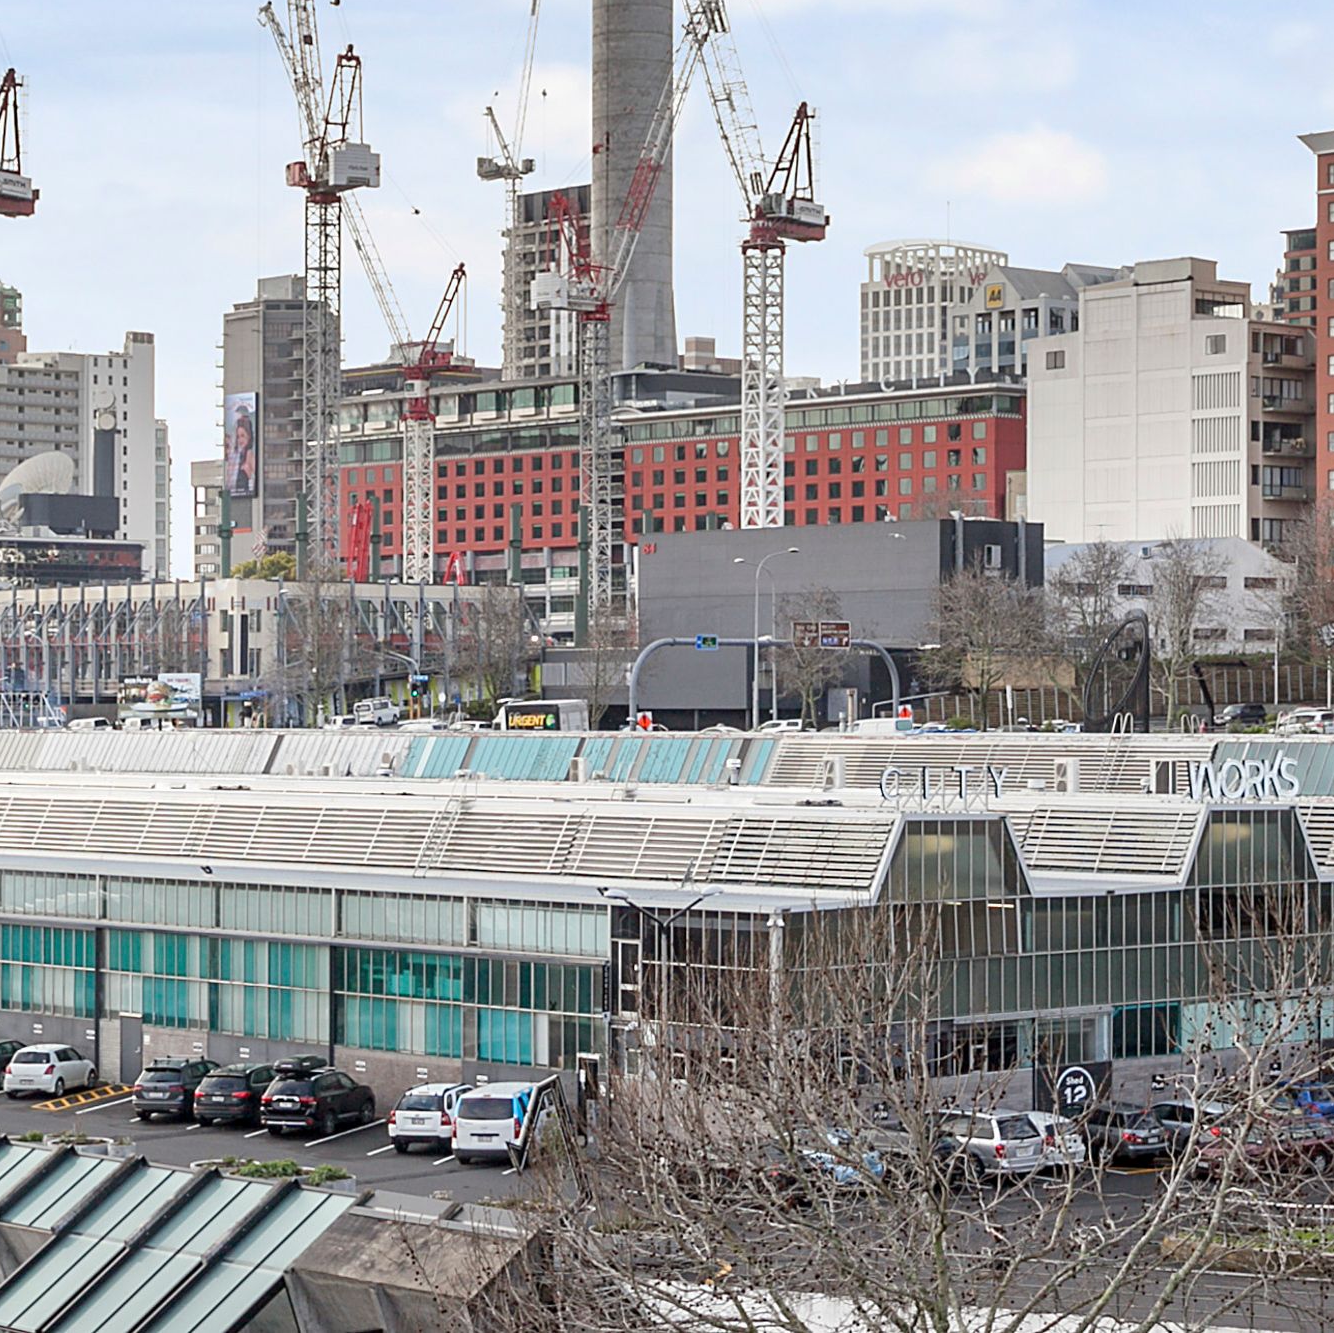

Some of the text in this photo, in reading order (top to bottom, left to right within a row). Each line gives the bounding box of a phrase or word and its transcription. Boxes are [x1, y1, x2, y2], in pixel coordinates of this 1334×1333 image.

[884, 270, 923, 288] vero
[988, 289, 1002, 302] AA
[880, 366, 980, 393] CITY
[509, 713, 546, 727] URGENT
[879, 765, 1009, 802] CITY
[1187, 749, 1300, 801] WORKS
[1065, 1075, 1084, 1086] Shed
[1063, 1085, 1087, 1104] 12
